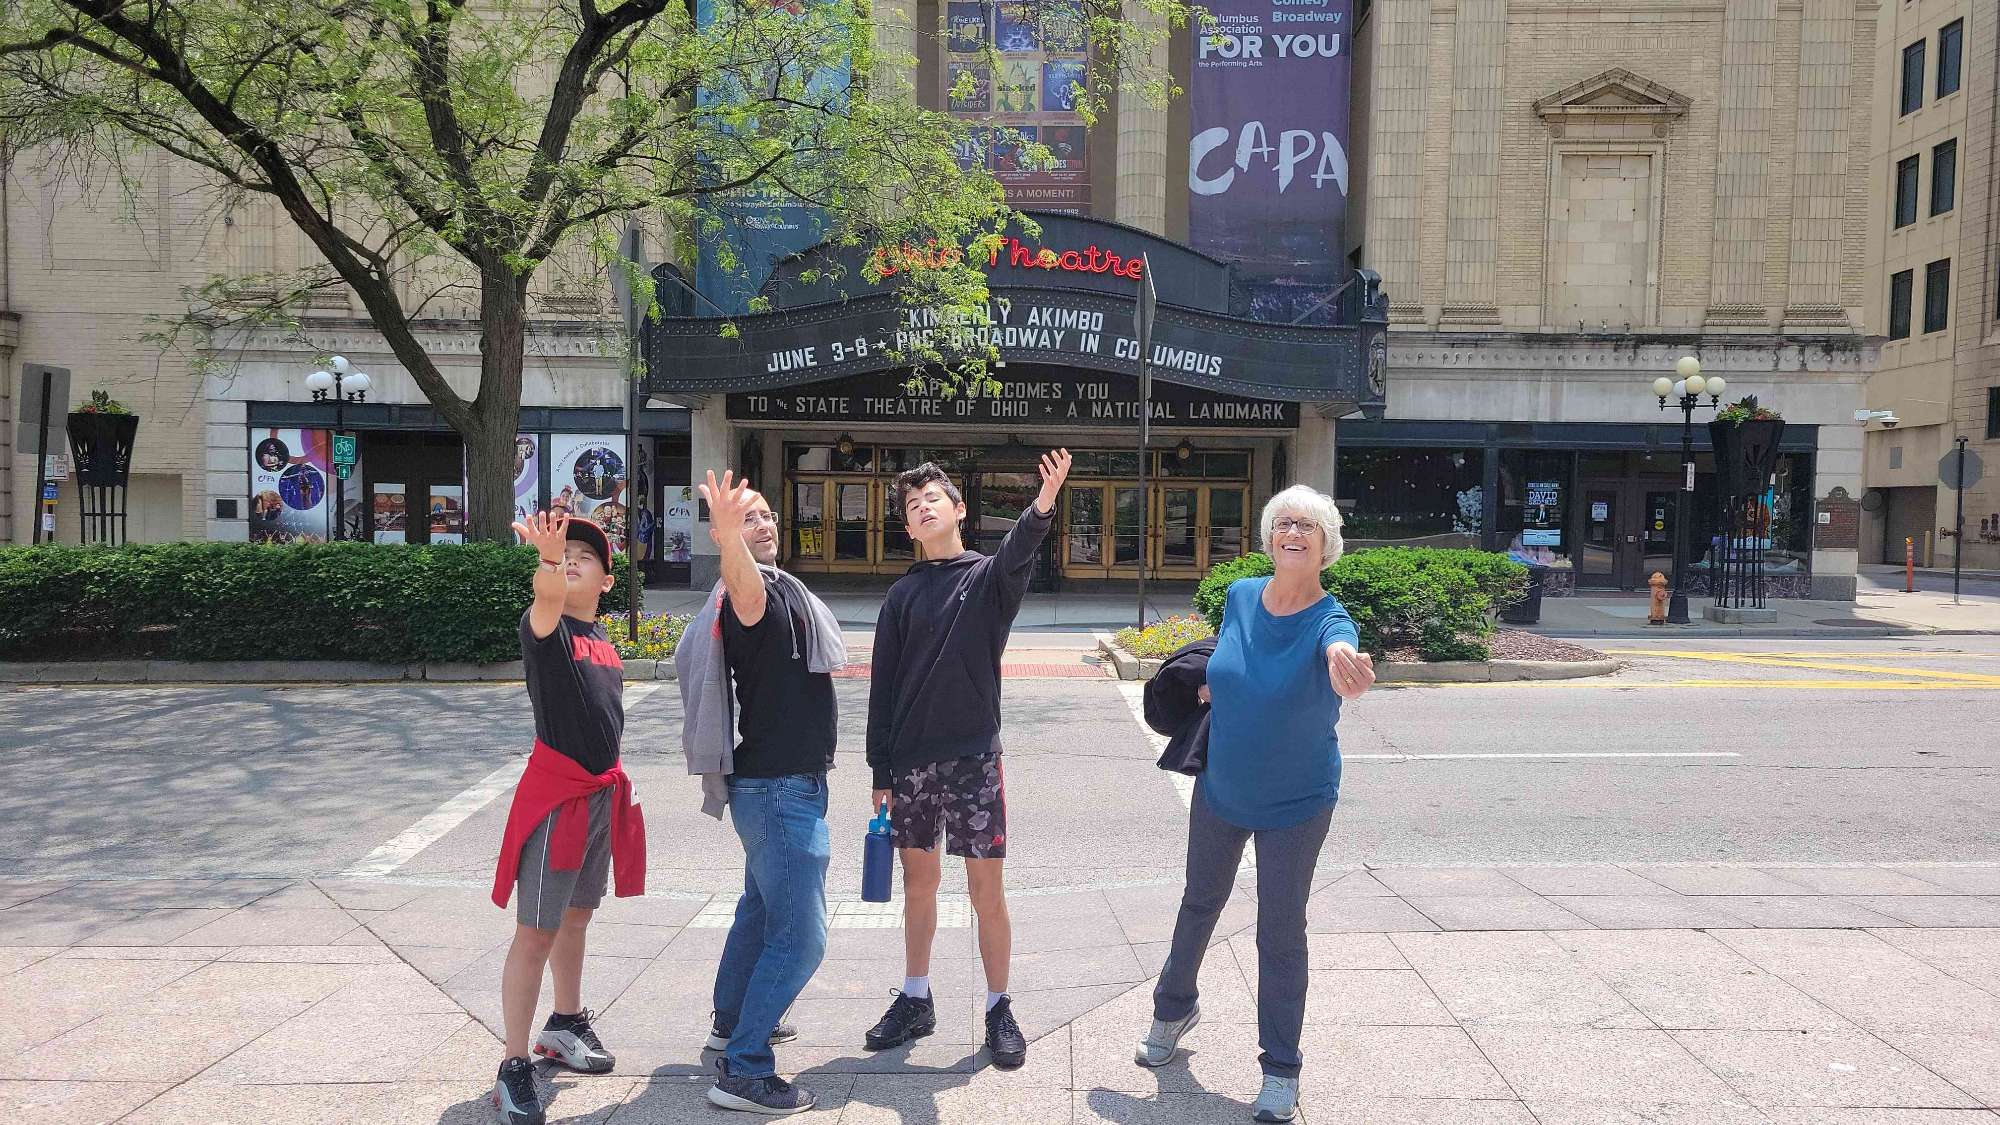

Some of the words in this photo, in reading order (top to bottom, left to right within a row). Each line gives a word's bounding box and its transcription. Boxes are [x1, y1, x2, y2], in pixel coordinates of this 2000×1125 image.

[1201, 13, 1260, 23] lumbus
[1272, 11, 1342, 24] Broadway
[1200, 34, 1263, 59] FOR
[1271, 33, 1340, 58] YOU
[1210, 60, 1247, 68] Performing
[997, 83, 1036, 92] shuked
[1189, 121, 1349, 197] CAPA
[1016, 189, 1024, 198] A
[1026, 189, 1074, 198] MOMENT!
[984, 237, 1144, 280] Theatre
[909, 302, 1012, 328] KIMERLY
[1027, 307, 1104, 332] AKIMBO
[767, 346, 818, 373] JUNE
[831, 338, 868, 362] 3-8
[1079, 333, 1100, 354] IN
[1114, 338, 1223, 376] COUMBUS
[907, 380, 956, 399] CAP
[1076, 383, 1109, 400] YOU
[747, 396, 768, 413] TO
[795, 396, 849, 414] STATE
[864, 397, 943, 417] THEATRE
[955, 400, 977, 416] OF
[991, 400, 1030, 417] OHIO
[1066, 402, 1078, 418] A
[1091, 401, 1176, 419] NATIONAL
[1189, 402, 1284, 420] LANDMARK
[1528, 491, 1558, 500] DAVID
